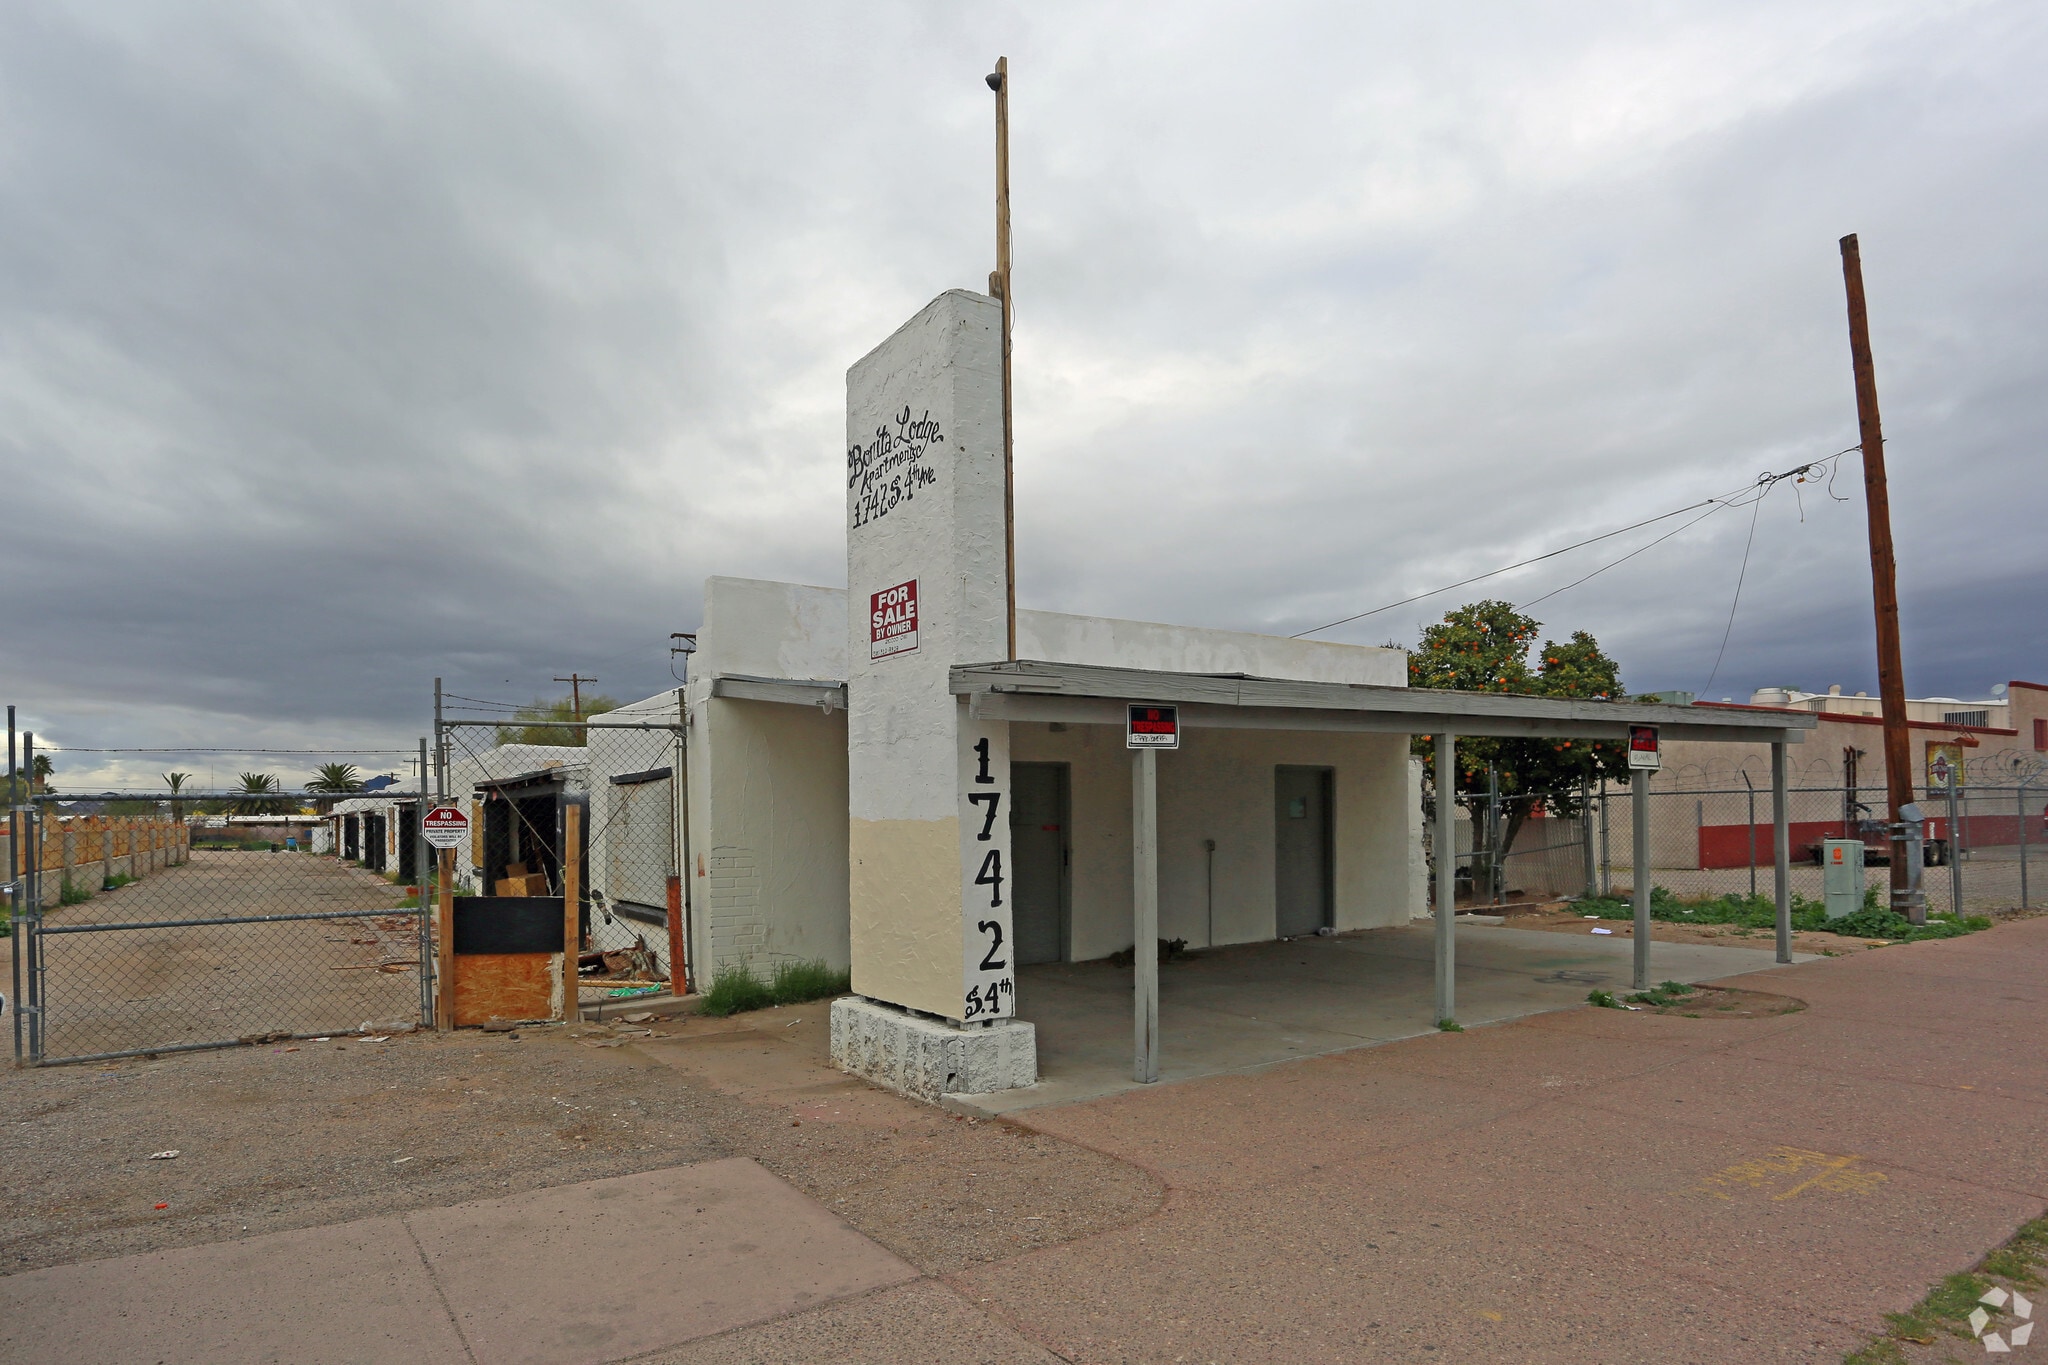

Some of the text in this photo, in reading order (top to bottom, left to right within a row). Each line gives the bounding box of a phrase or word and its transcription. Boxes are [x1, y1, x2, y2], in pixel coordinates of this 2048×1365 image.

[848, 405, 944, 489] Bonita Lodge
[860, 443, 917, 495] Apartments
[853, 483, 888, 529] 1742
[878, 585, 909, 610] FOR
[872, 600, 916, 629] SALE
[876, 628, 886, 640] BY
[886, 620, 912, 637] OWNER
[1132, 721, 1175, 733] TRESPASSING
[1147, 709, 1159, 721] NO
[440, 811, 452, 819] NO
